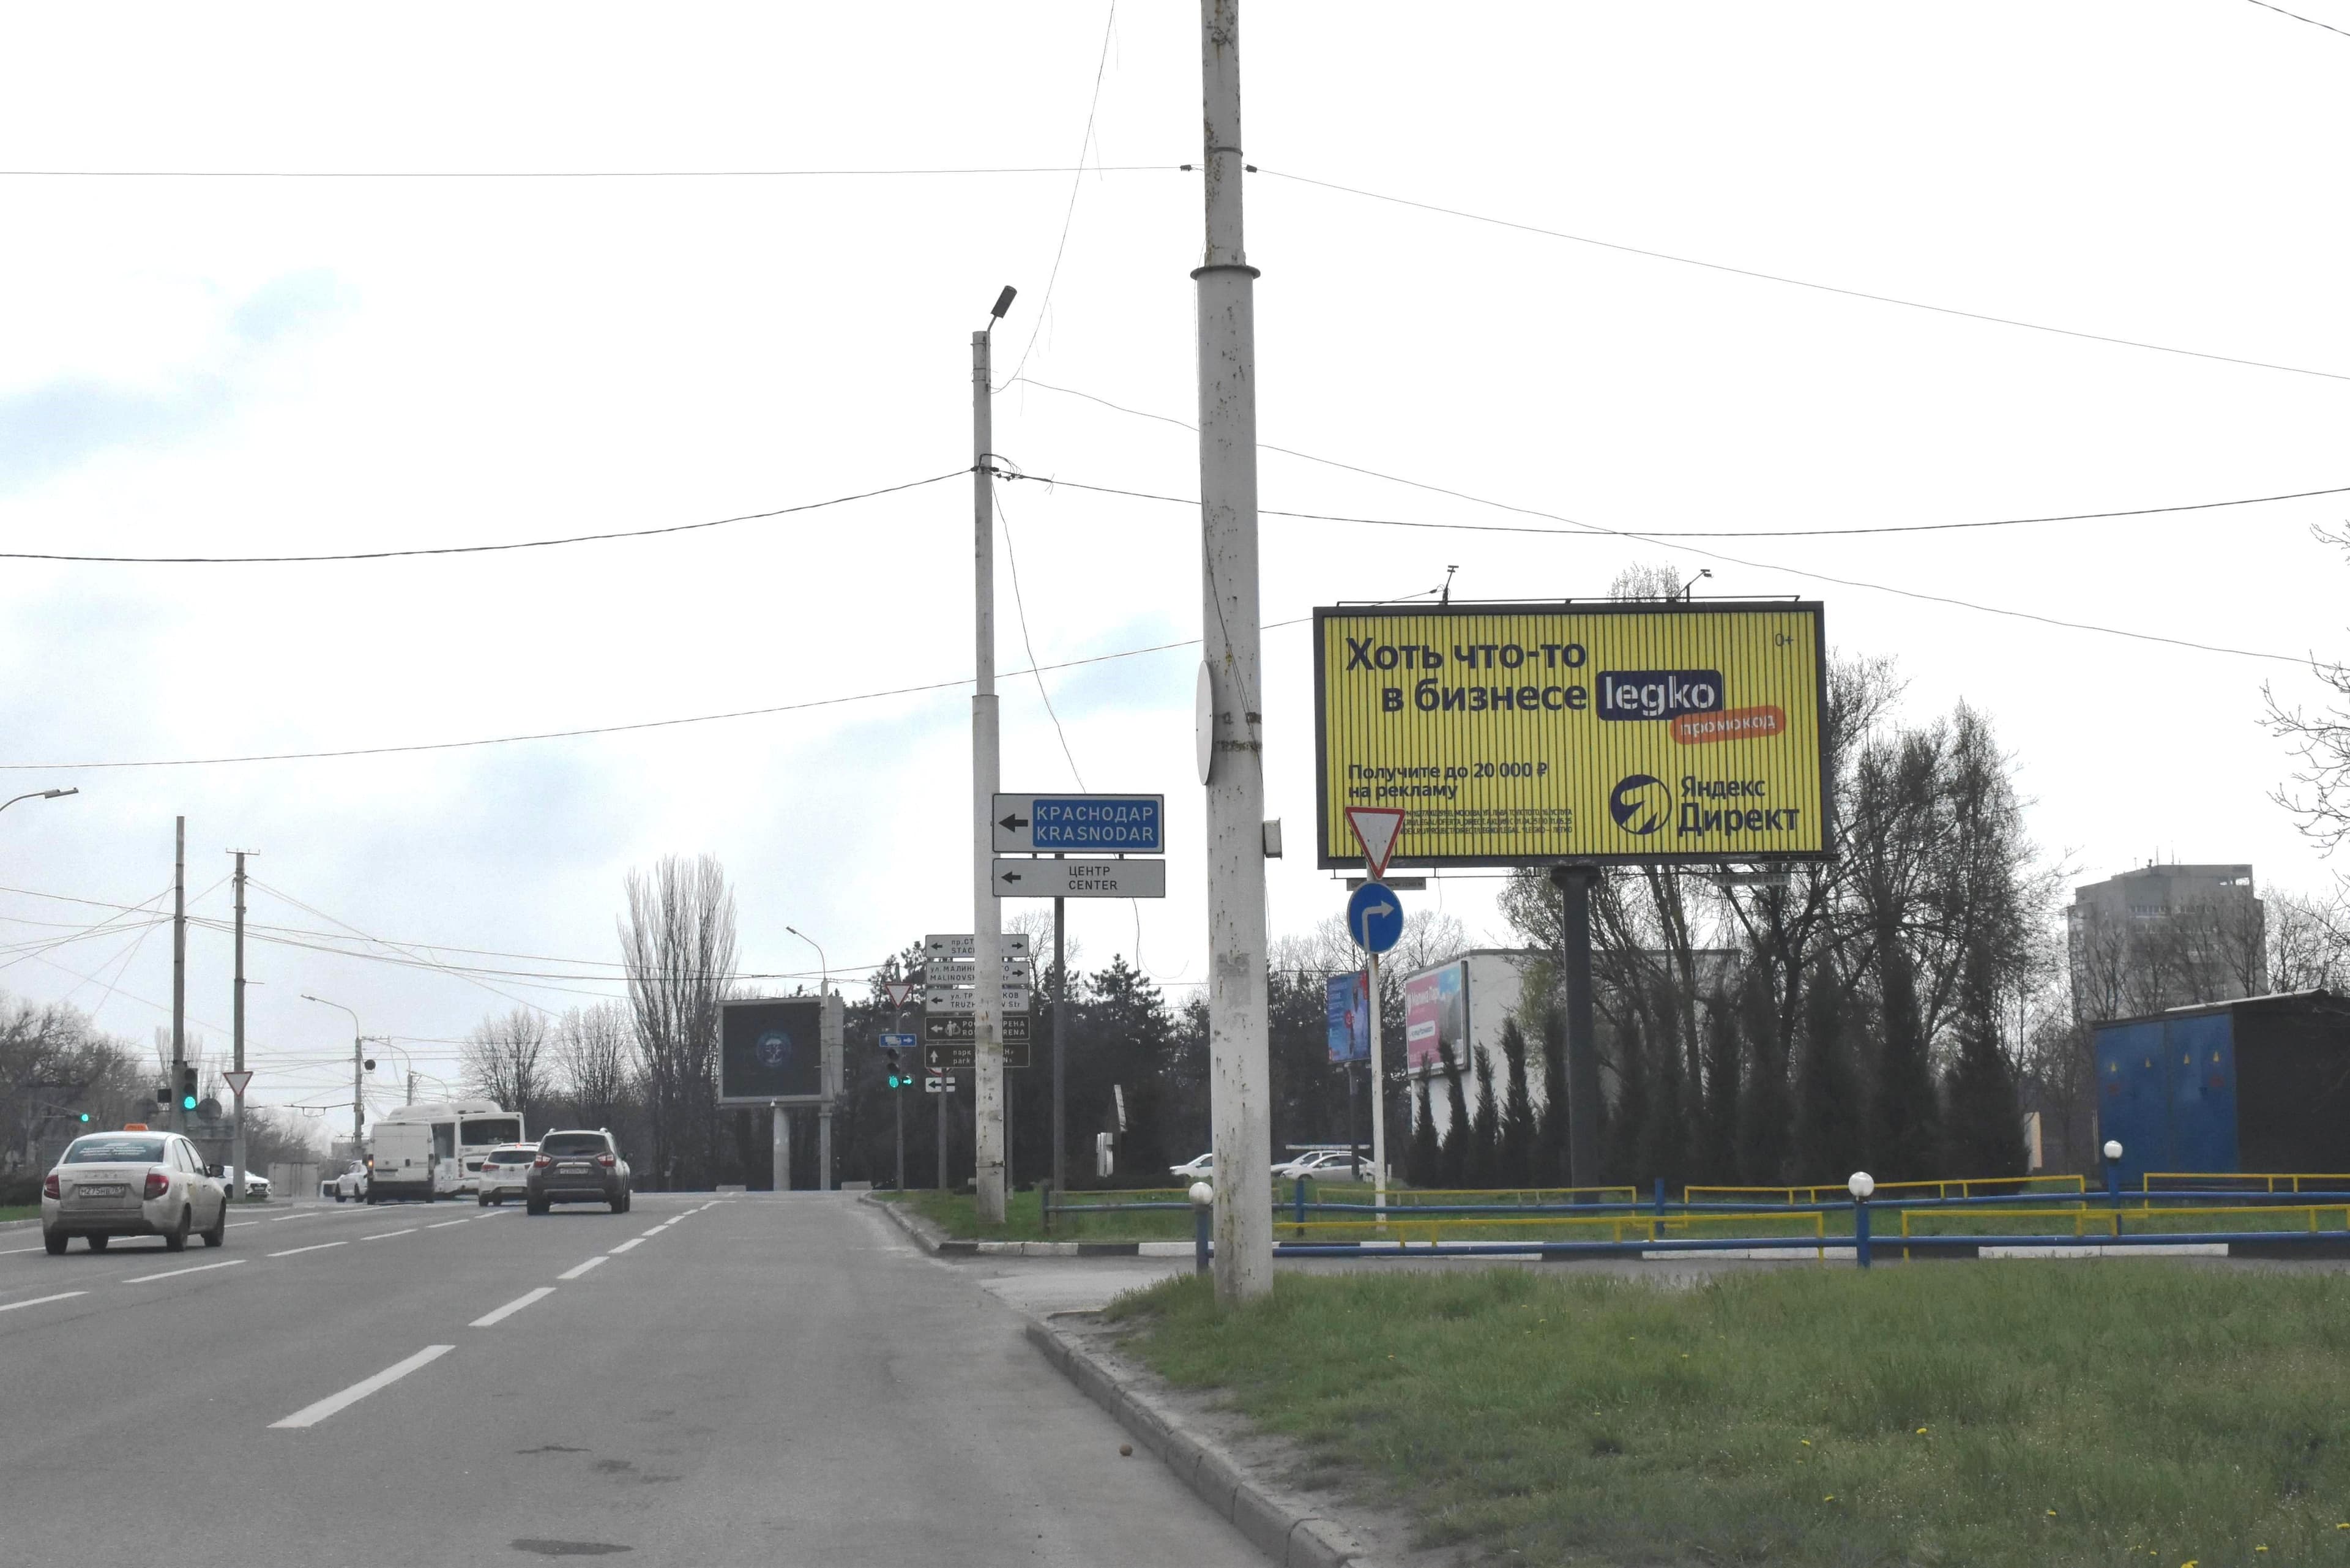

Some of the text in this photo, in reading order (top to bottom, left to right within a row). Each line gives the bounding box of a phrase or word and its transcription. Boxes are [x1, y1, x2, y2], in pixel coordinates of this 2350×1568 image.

[1775, 633, 1794, 647] 0+
[1346, 637, 1586, 670] Хоть что-то
[1382, 678, 1587, 712] в бизнесе
[1605, 676, 1715, 717] legko
[1680, 714, 1775, 737] промокод
[1348, 764, 1441, 782] Получите
[1444, 766, 1468, 780] до
[1473, 763, 1495, 778] 20
[1499, 763, 1532, 778] 000
[1348, 784, 1458, 800] на рекламу
[1681, 776, 1765, 799] Яндекс
[1037, 807, 1153, 823] КРАСНОДАР
[1679, 802, 1799, 837] Директ
[1037, 827, 1154, 841] KRASNODAR
[1070, 867, 1110, 878] ЦЕНТР
[1069, 880, 1117, 890] CENTER
